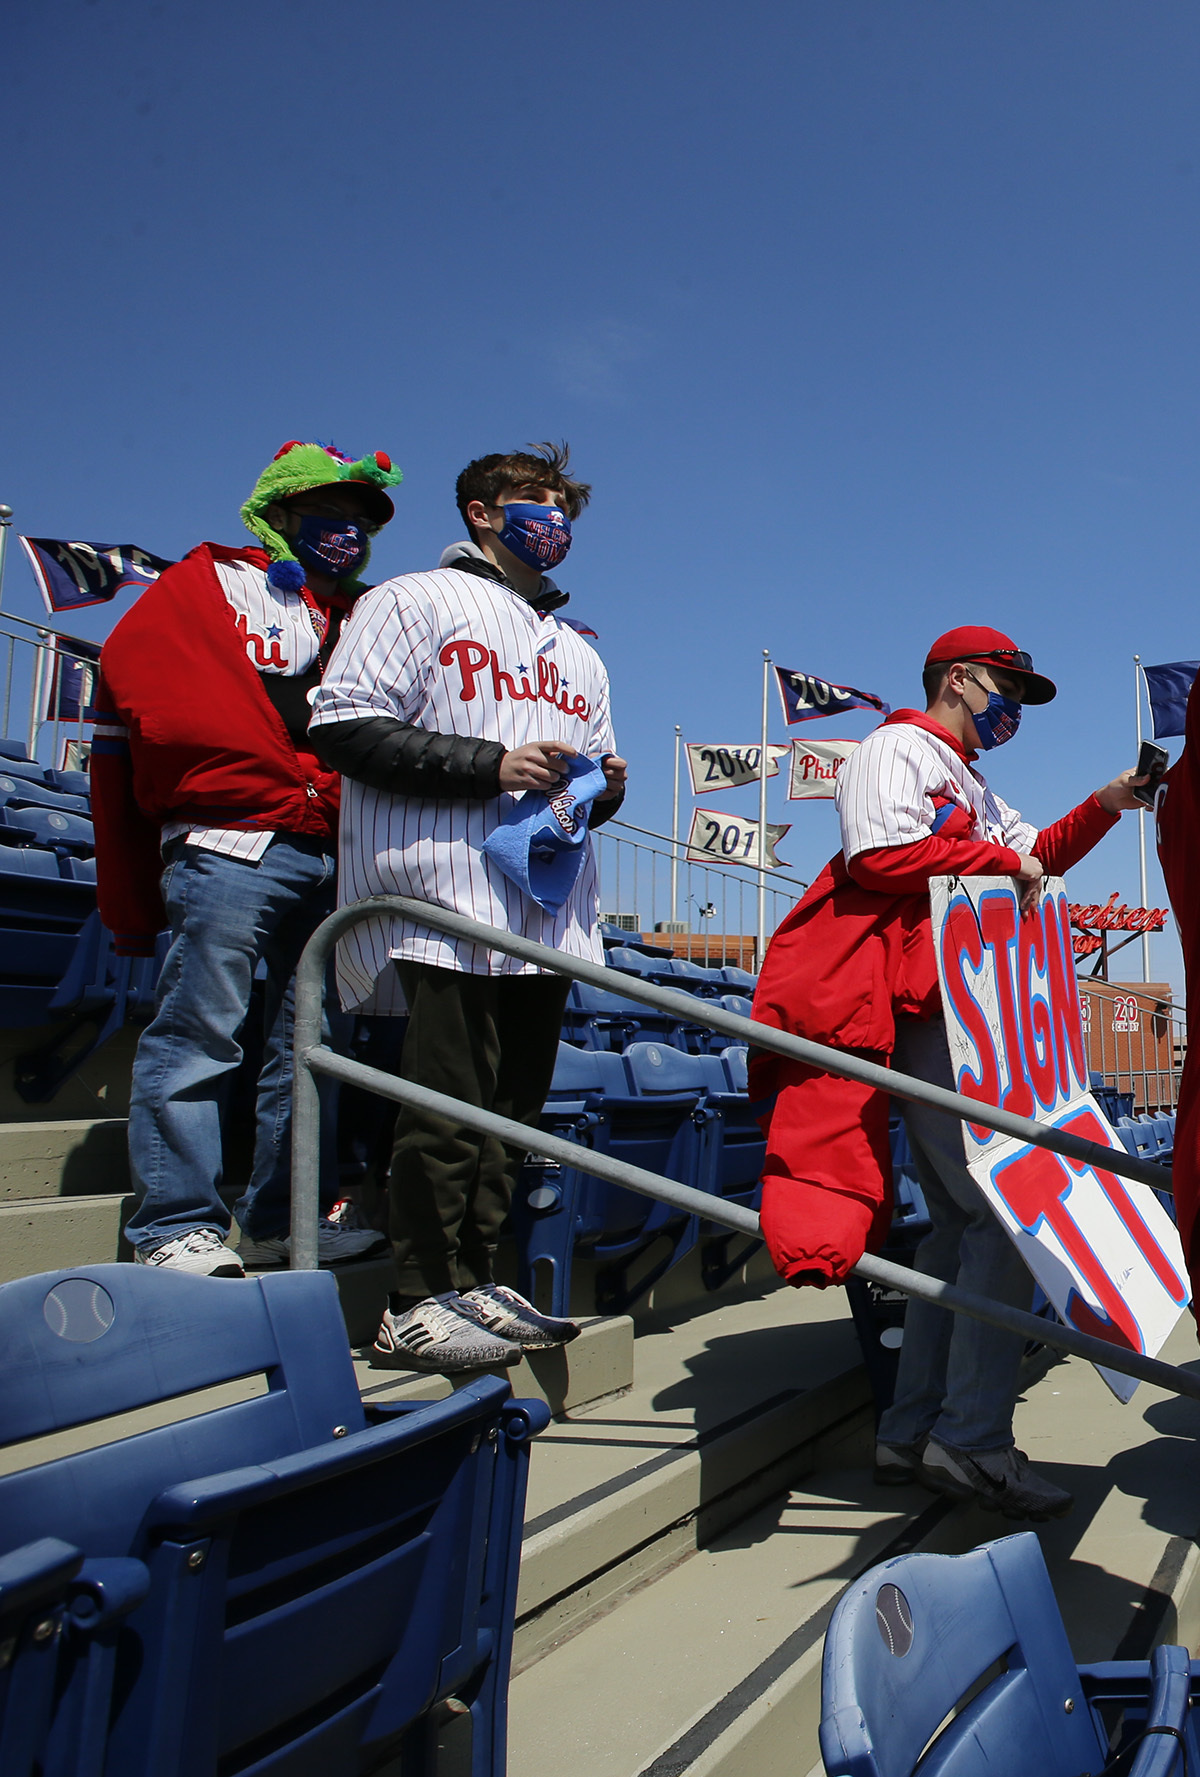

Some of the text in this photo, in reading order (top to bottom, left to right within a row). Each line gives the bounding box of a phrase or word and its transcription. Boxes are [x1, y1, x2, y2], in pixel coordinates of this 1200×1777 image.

[439, 639, 591, 722] Phillie
[701, 748, 762, 782] 2010
[938, 888, 1087, 1147] SIGN
[1112, 995, 1138, 1022] 20
